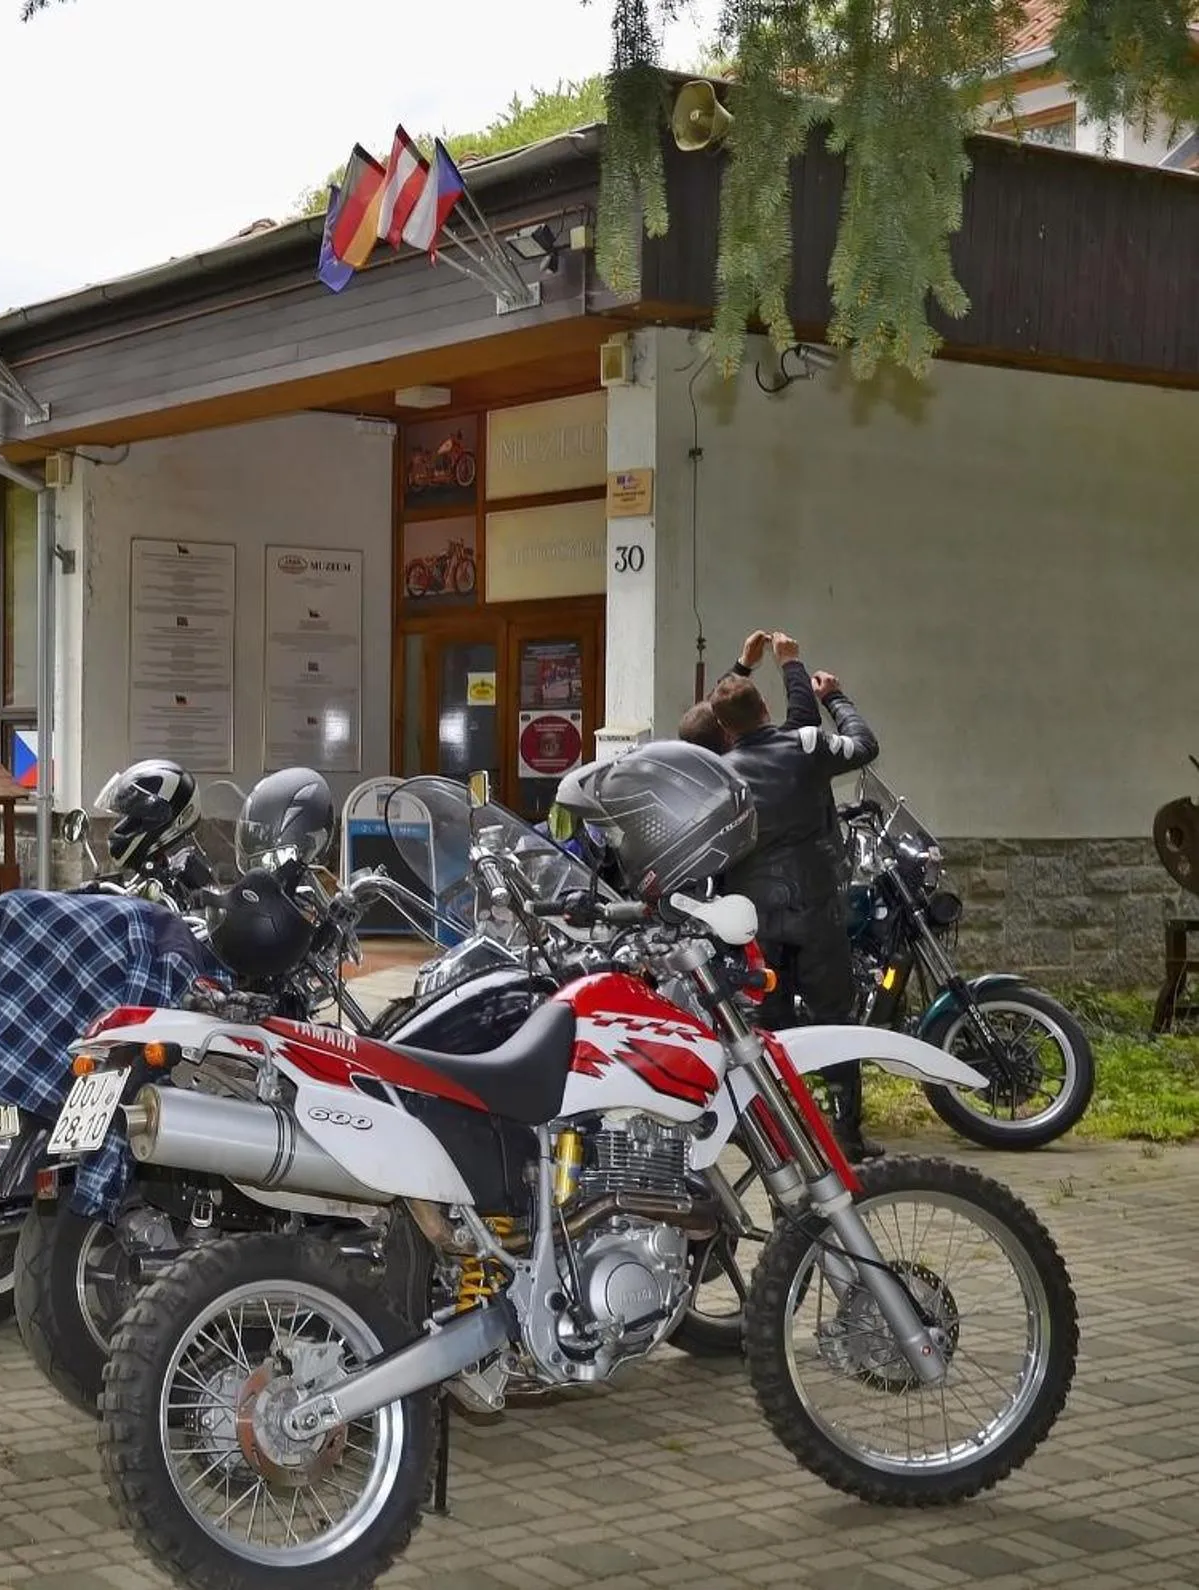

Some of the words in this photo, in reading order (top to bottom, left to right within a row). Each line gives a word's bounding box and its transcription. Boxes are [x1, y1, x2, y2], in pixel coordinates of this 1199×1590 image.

[310, 561, 351, 573] MUZEUM
[614, 544, 645, 572] 30
[294, 1022, 357, 1054] YAMAHA
[308, 1106, 373, 1130] 600
